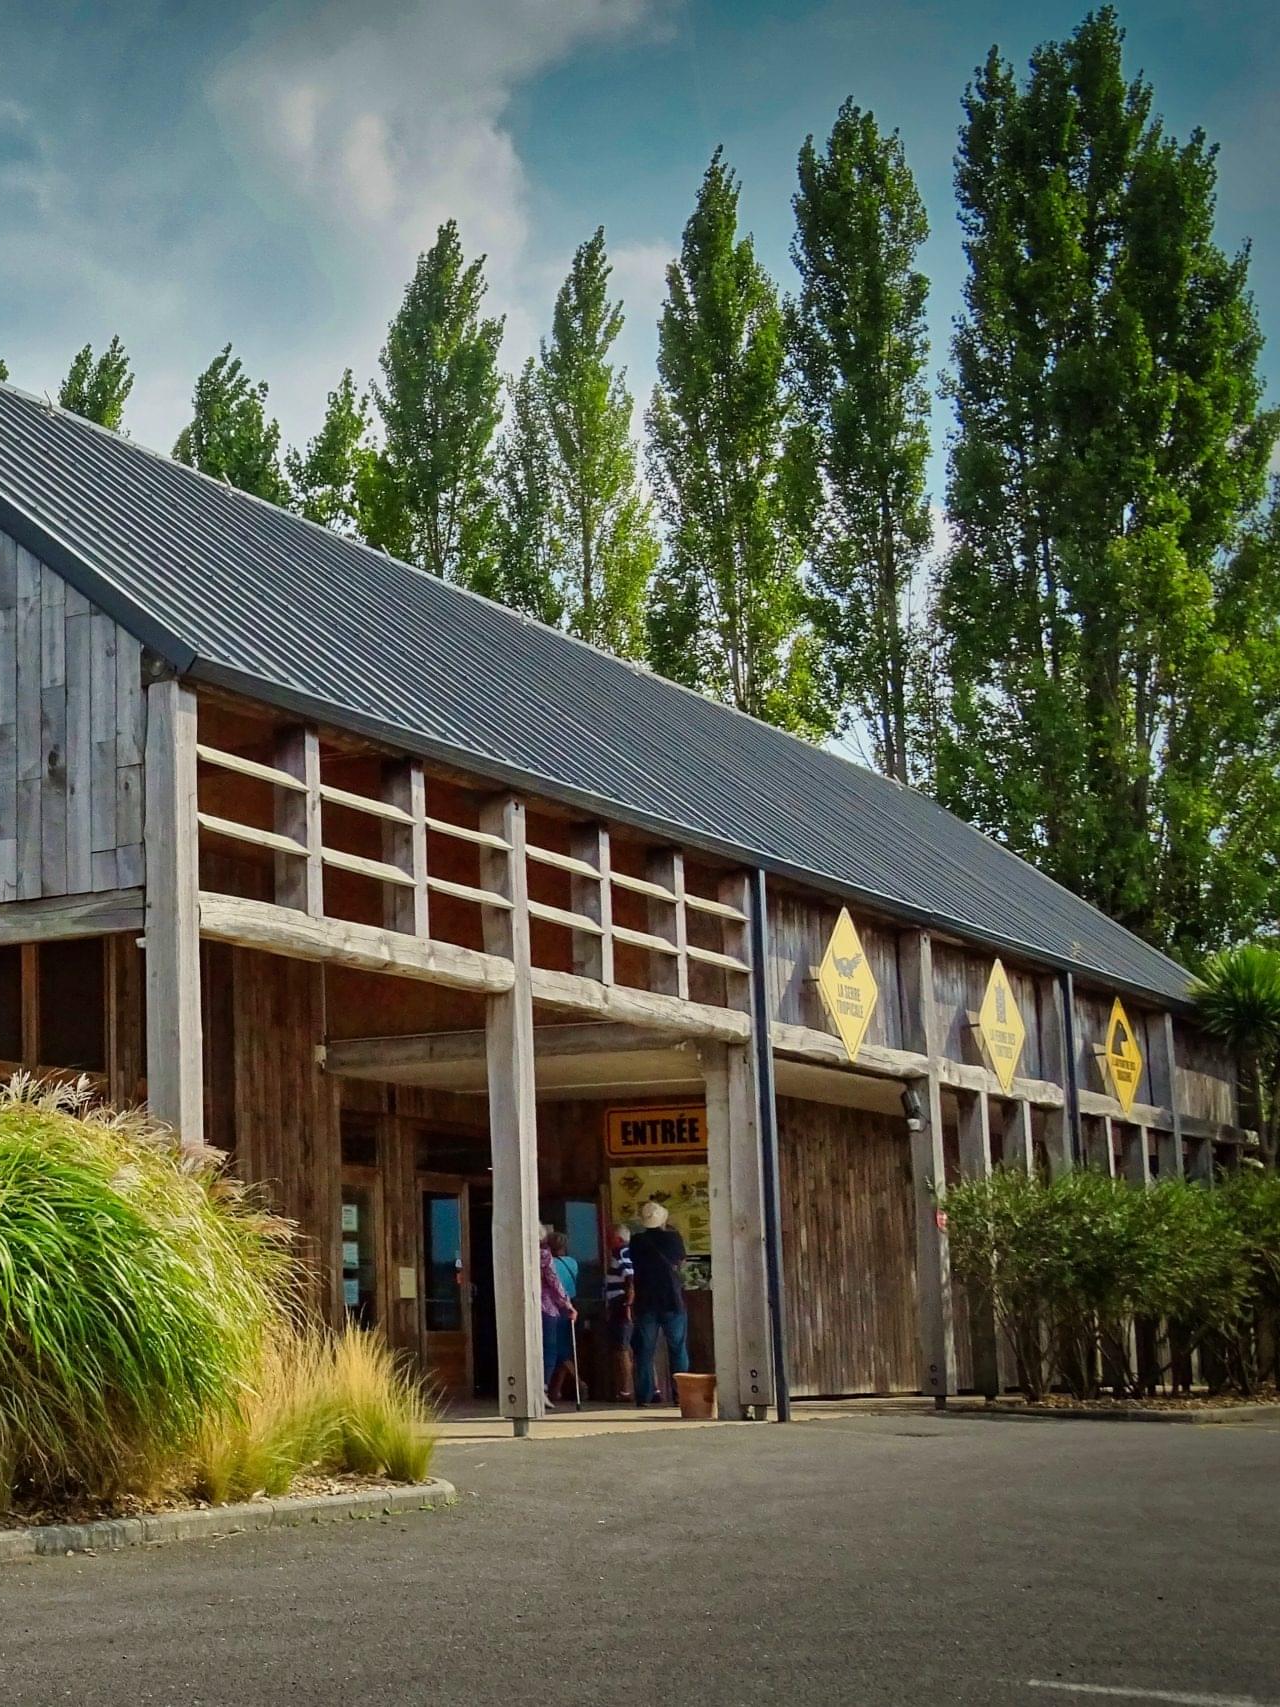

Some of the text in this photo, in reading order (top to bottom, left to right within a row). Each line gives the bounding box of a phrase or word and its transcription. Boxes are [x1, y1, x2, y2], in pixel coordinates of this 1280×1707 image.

[837, 983, 861, 1001] LA SERRE
[836, 999, 864, 1019] TROPICALE
[622, 1112, 700, 1146] ENTRÉE
